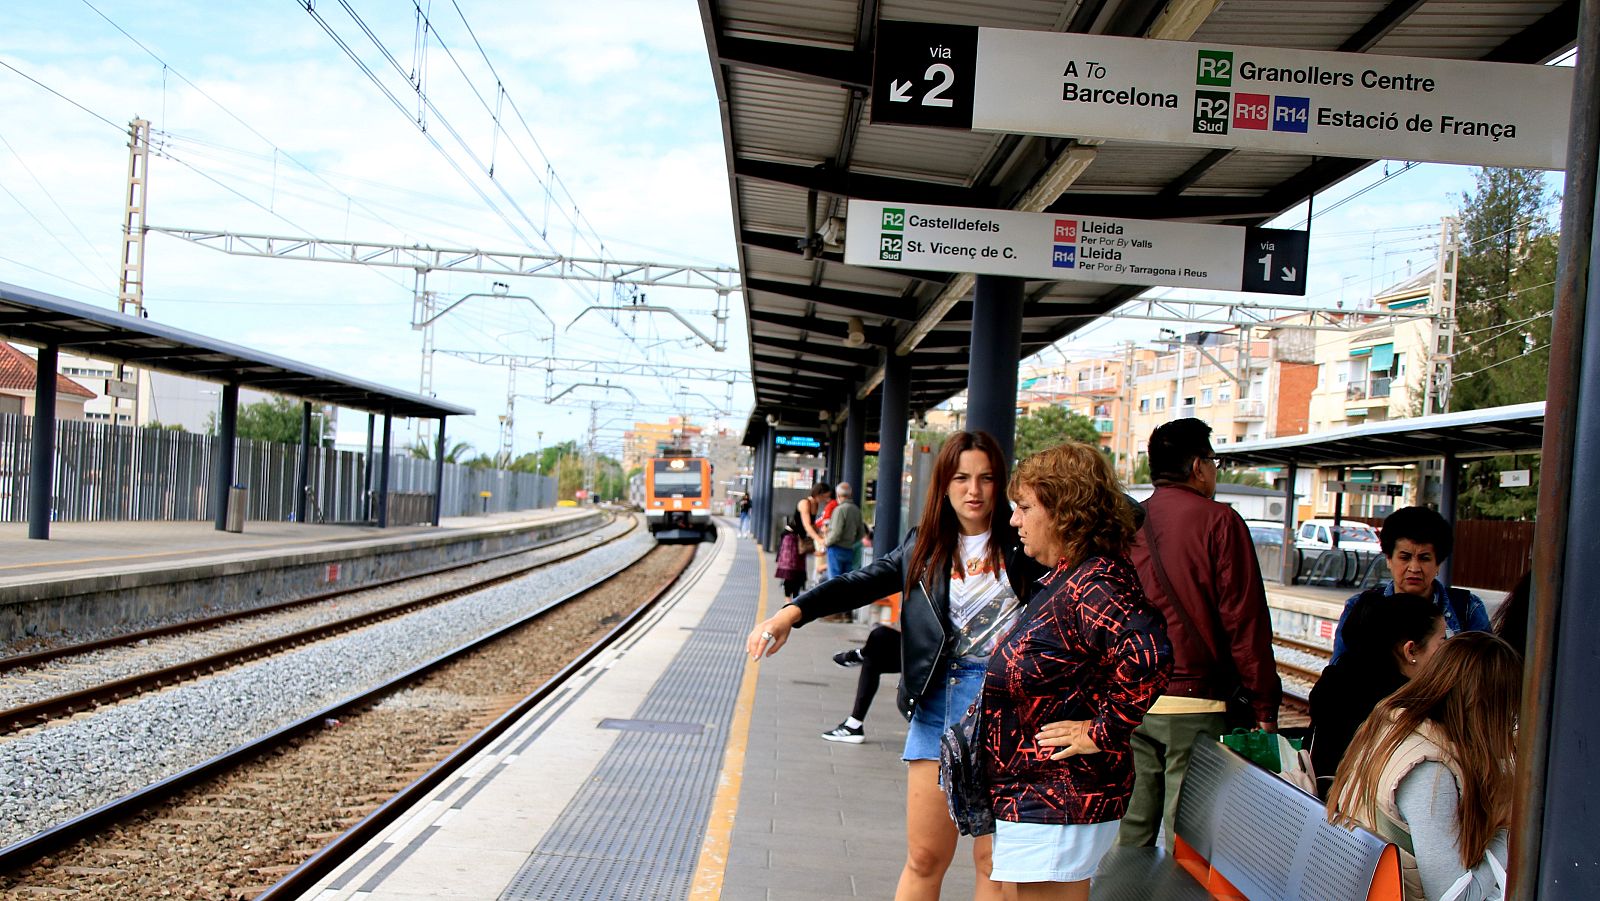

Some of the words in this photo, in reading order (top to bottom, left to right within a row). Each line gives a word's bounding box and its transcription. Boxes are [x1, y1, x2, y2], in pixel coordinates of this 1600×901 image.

[930, 45, 951, 59] via
[1063, 60, 1079, 78] A
[1086, 62, 1106, 79] To
[1199, 58, 1231, 80] R2
[1239, 61, 1354, 88] Granollers
[1361, 69, 1436, 93] Centre
[921, 63, 955, 108] 2
[1062, 82, 1178, 109] Barcelona
[1196, 98, 1228, 120] R2
[1236, 103, 1268, 121] R13
[1275, 105, 1307, 123] R14
[1317, 107, 1399, 131] Estació
[1405, 114, 1434, 133] de
[1440, 116, 1517, 143] França
[1198, 120, 1224, 133] Sud
[883, 211, 904, 227] R2
[909, 214, 1000, 232] Castelldefels
[1055, 225, 1076, 237] R13
[1082, 221, 1124, 235] Lleida
[881, 237, 903, 252] R2
[907, 240, 926, 253] St.
[930, 242, 977, 260] Vicenç
[981, 245, 998, 258] de
[1002, 247, 1018, 259] C.
[1081, 235, 1097, 245] Per
[1099, 236, 1115, 245] Por
[1117, 237, 1129, 248] By
[1131, 238, 1153, 249] Valls
[1260, 241, 1275, 251] via
[882, 251, 899, 260] Sud
[1054, 251, 1075, 263] R14
[1080, 247, 1122, 261] Lleida
[1079, 261, 1096, 270] Per
[1097, 262, 1113, 271] Por
[1115, 263, 1127, 274] By
[1129, 265, 1176, 277] Tarragona
[1183, 268, 1208, 278] Reus
[1258, 253, 1272, 281] 1
